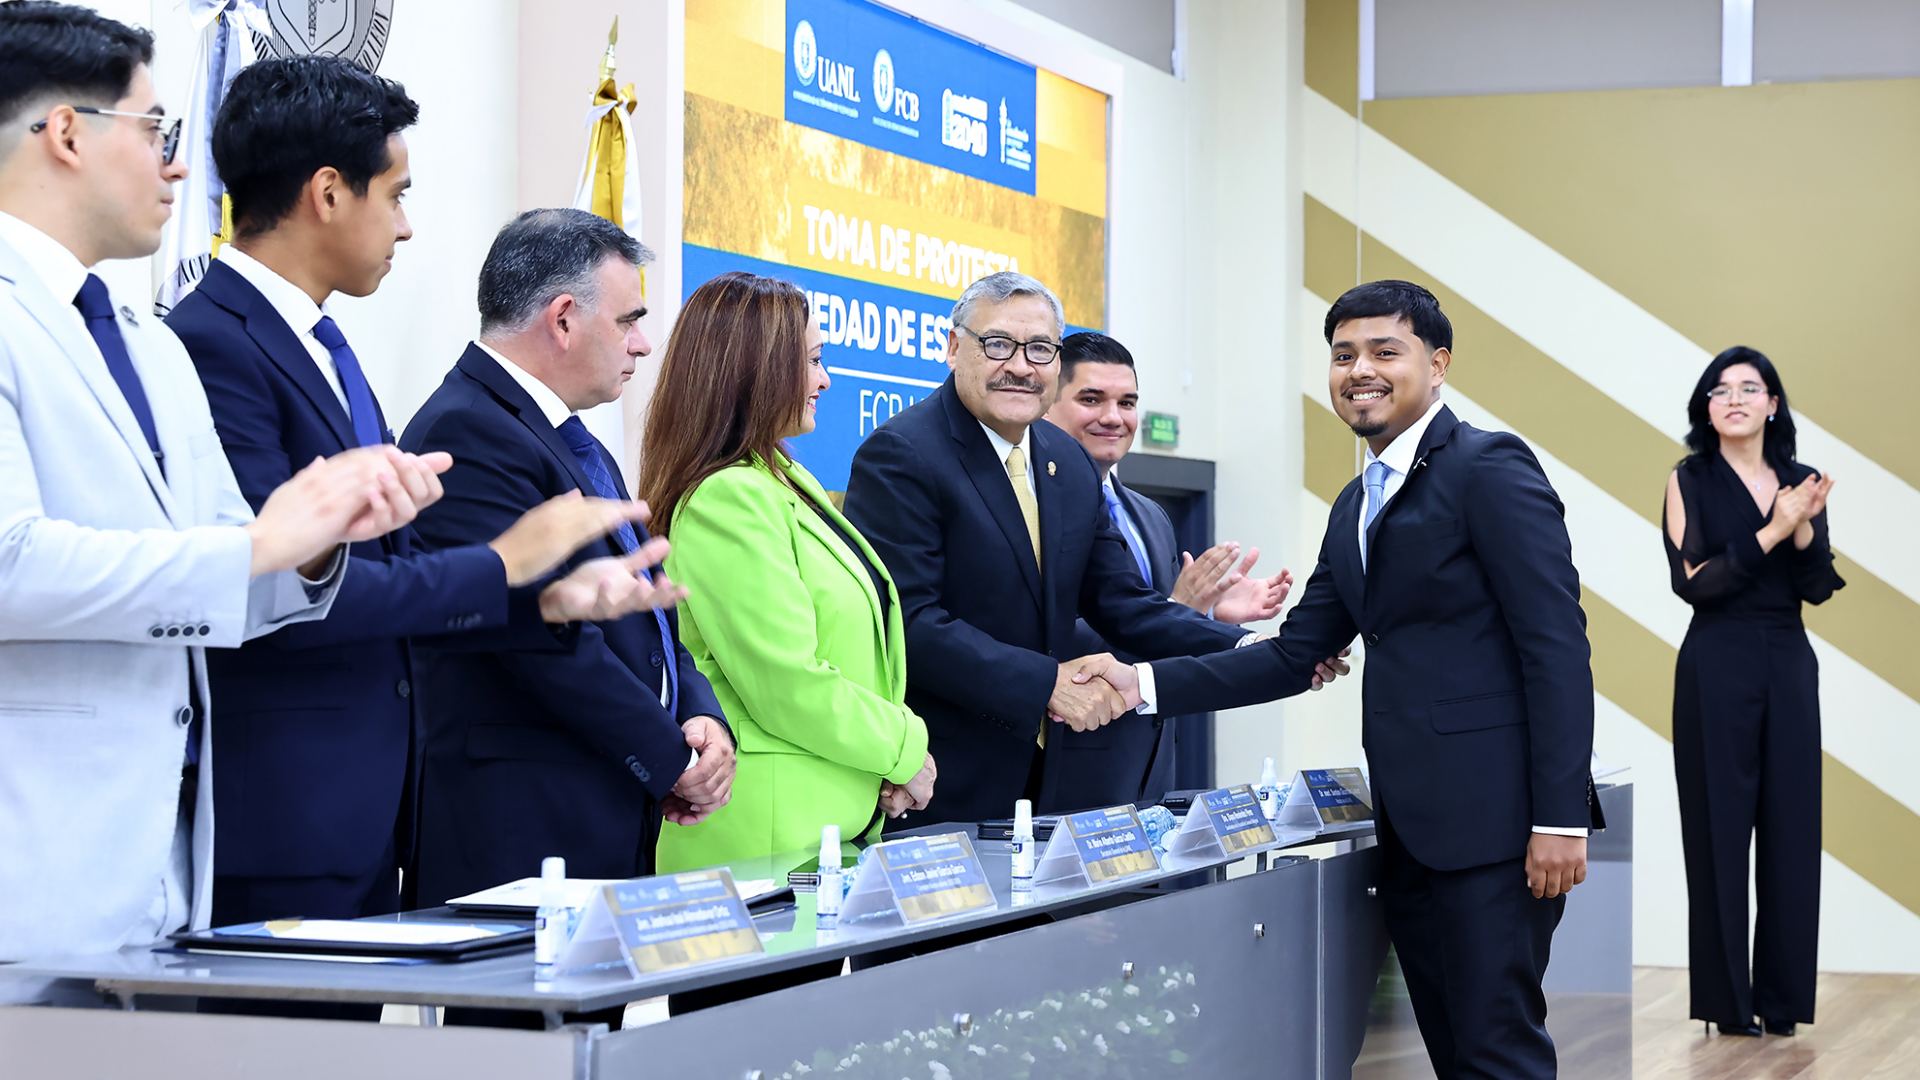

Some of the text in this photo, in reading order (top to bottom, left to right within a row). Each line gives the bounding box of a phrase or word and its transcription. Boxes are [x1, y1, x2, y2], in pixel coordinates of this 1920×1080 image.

[895, 88, 920, 122] FCB
[803, 204, 876, 270] TOMA
[880, 224, 911, 276] DE
[885, 305, 916, 358] DE
[920, 312, 954, 363] ES
